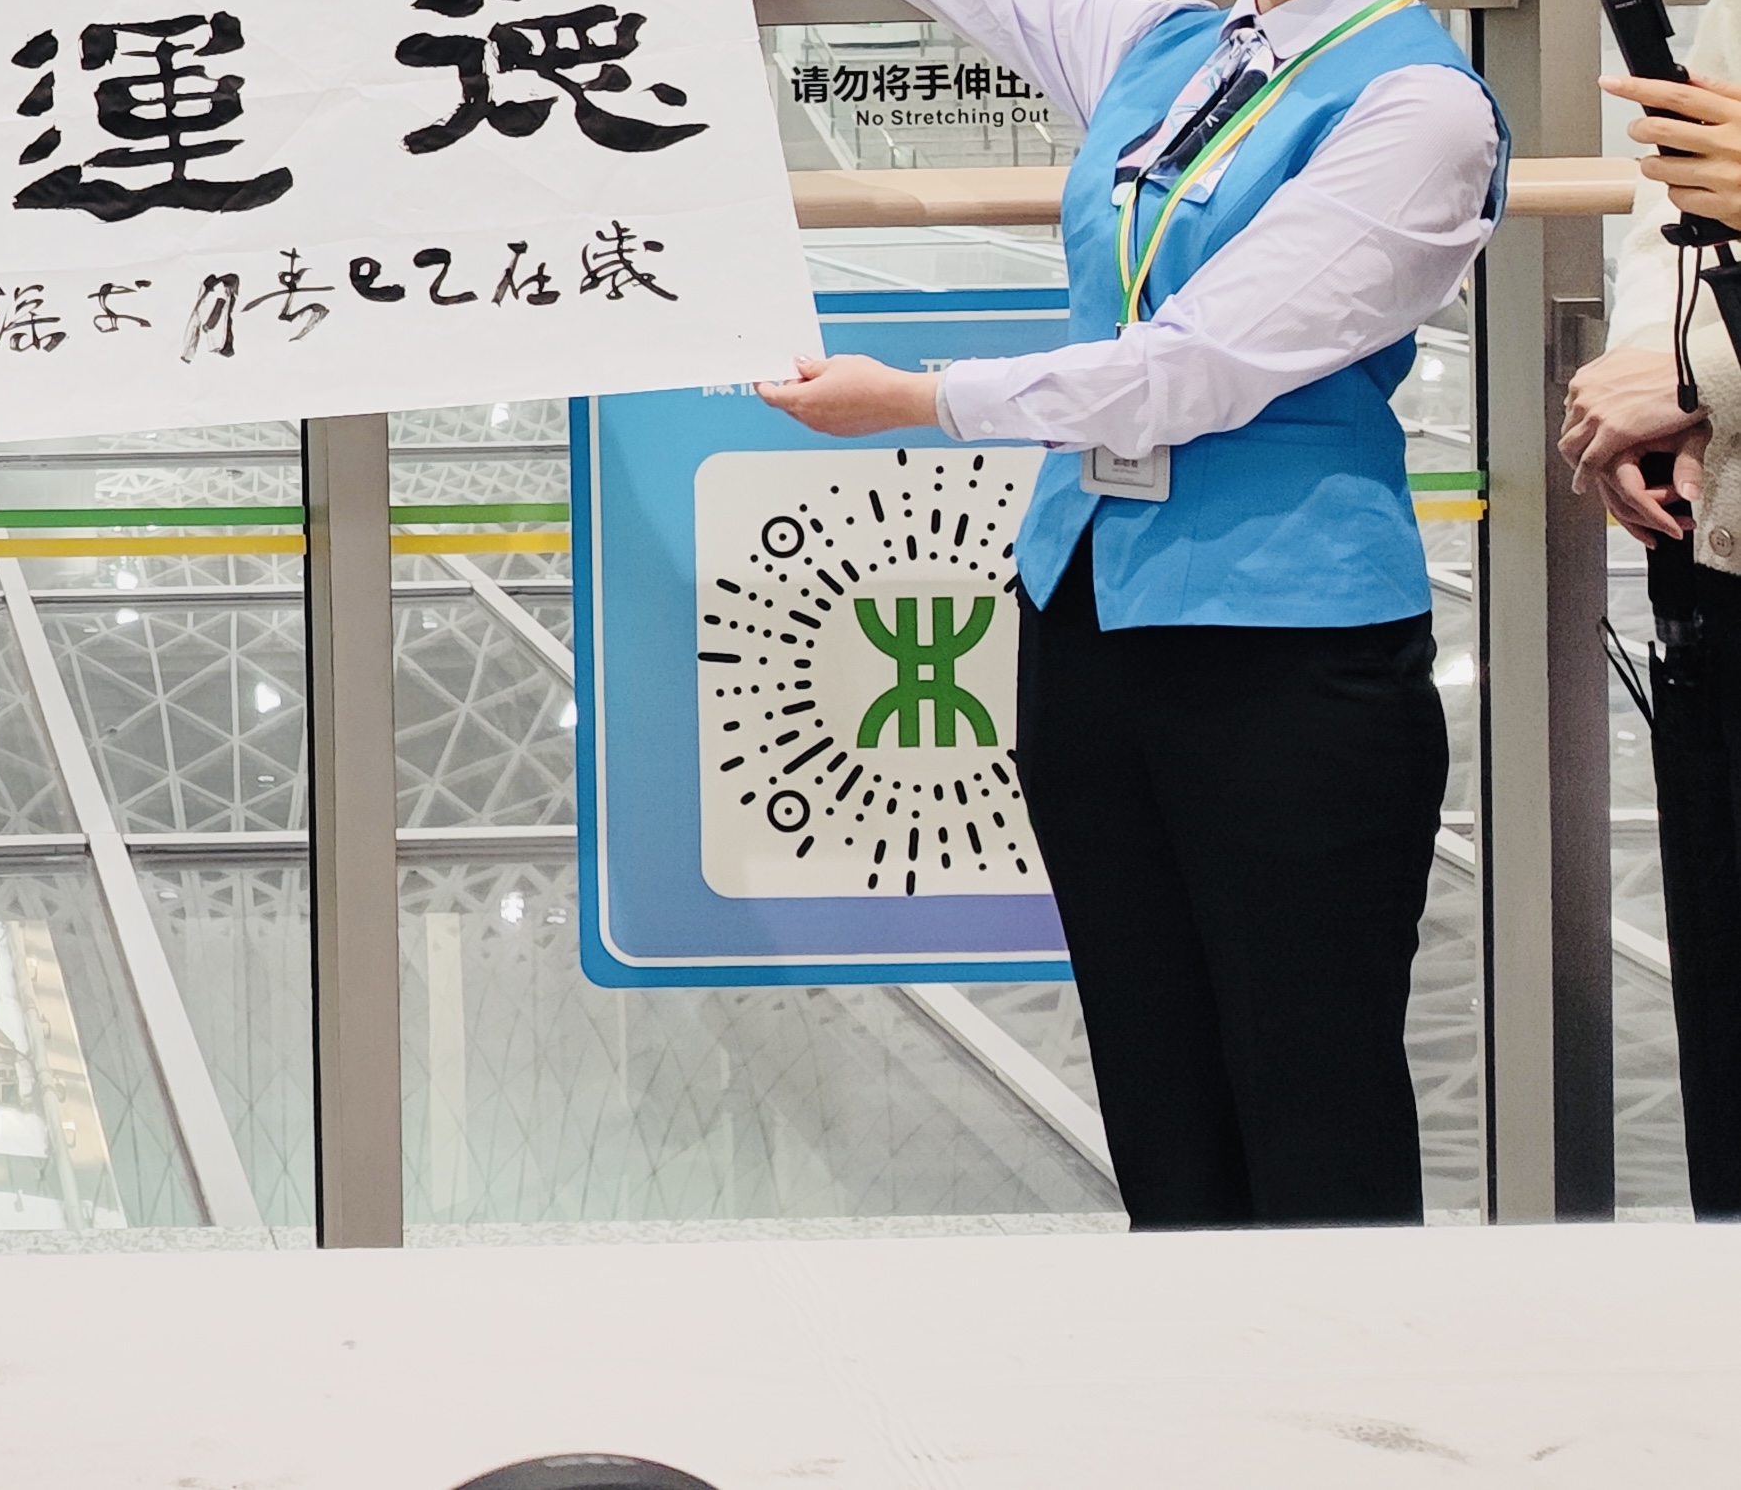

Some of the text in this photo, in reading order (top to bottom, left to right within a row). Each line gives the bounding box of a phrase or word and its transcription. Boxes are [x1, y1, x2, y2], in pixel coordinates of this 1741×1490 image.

[790, 62, 1044, 103] 请勿将手伸出
[856, 107, 1049, 127] No Stretching Out
